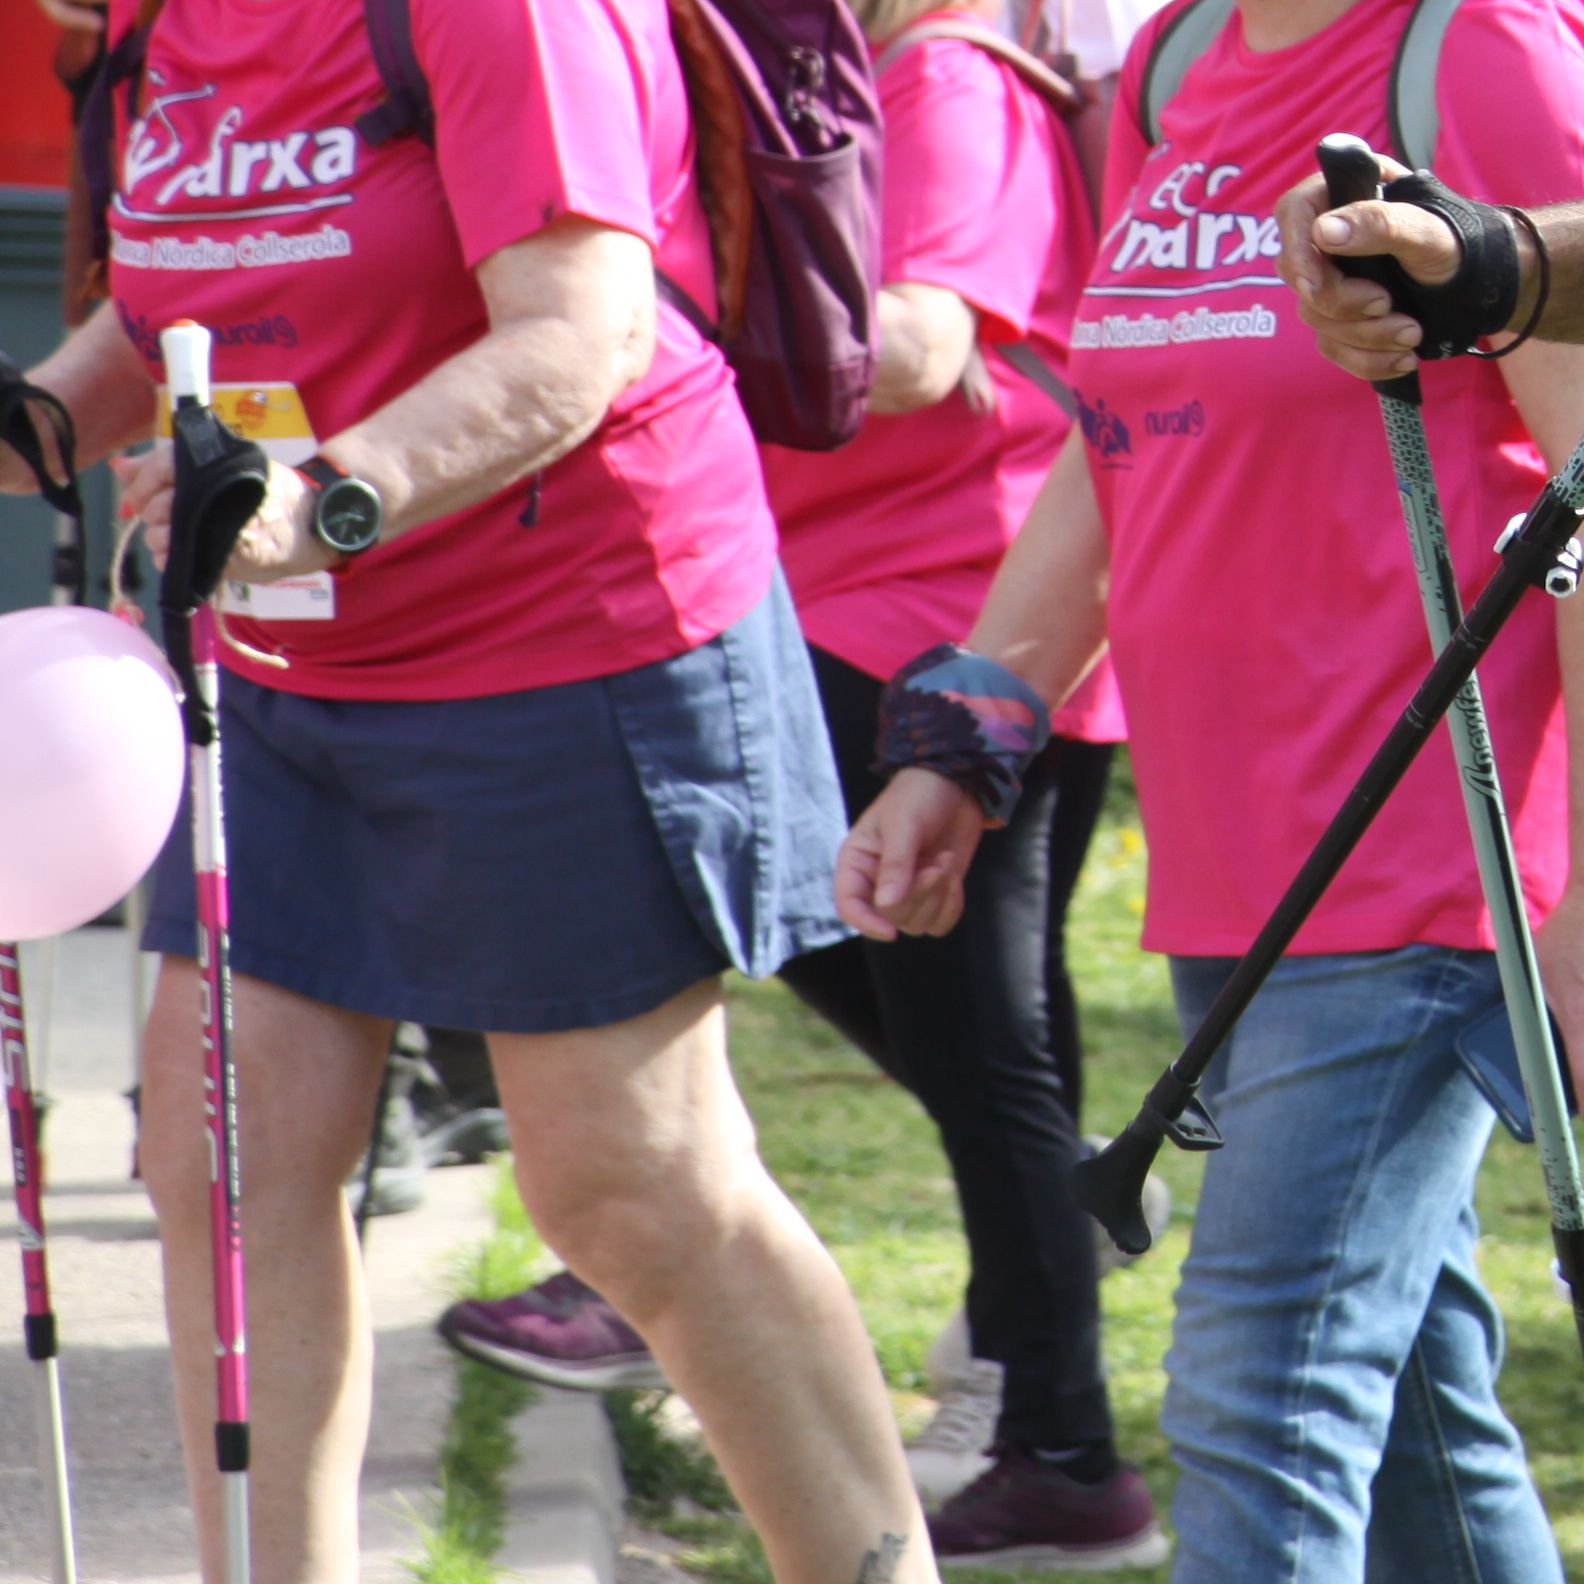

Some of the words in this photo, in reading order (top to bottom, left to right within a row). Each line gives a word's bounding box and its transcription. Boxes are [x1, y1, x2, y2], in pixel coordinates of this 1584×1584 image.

[157, 126, 358, 206] arxa
[237, 223, 352, 268] Collserola
[1169, 303, 1275, 343] Collserola
